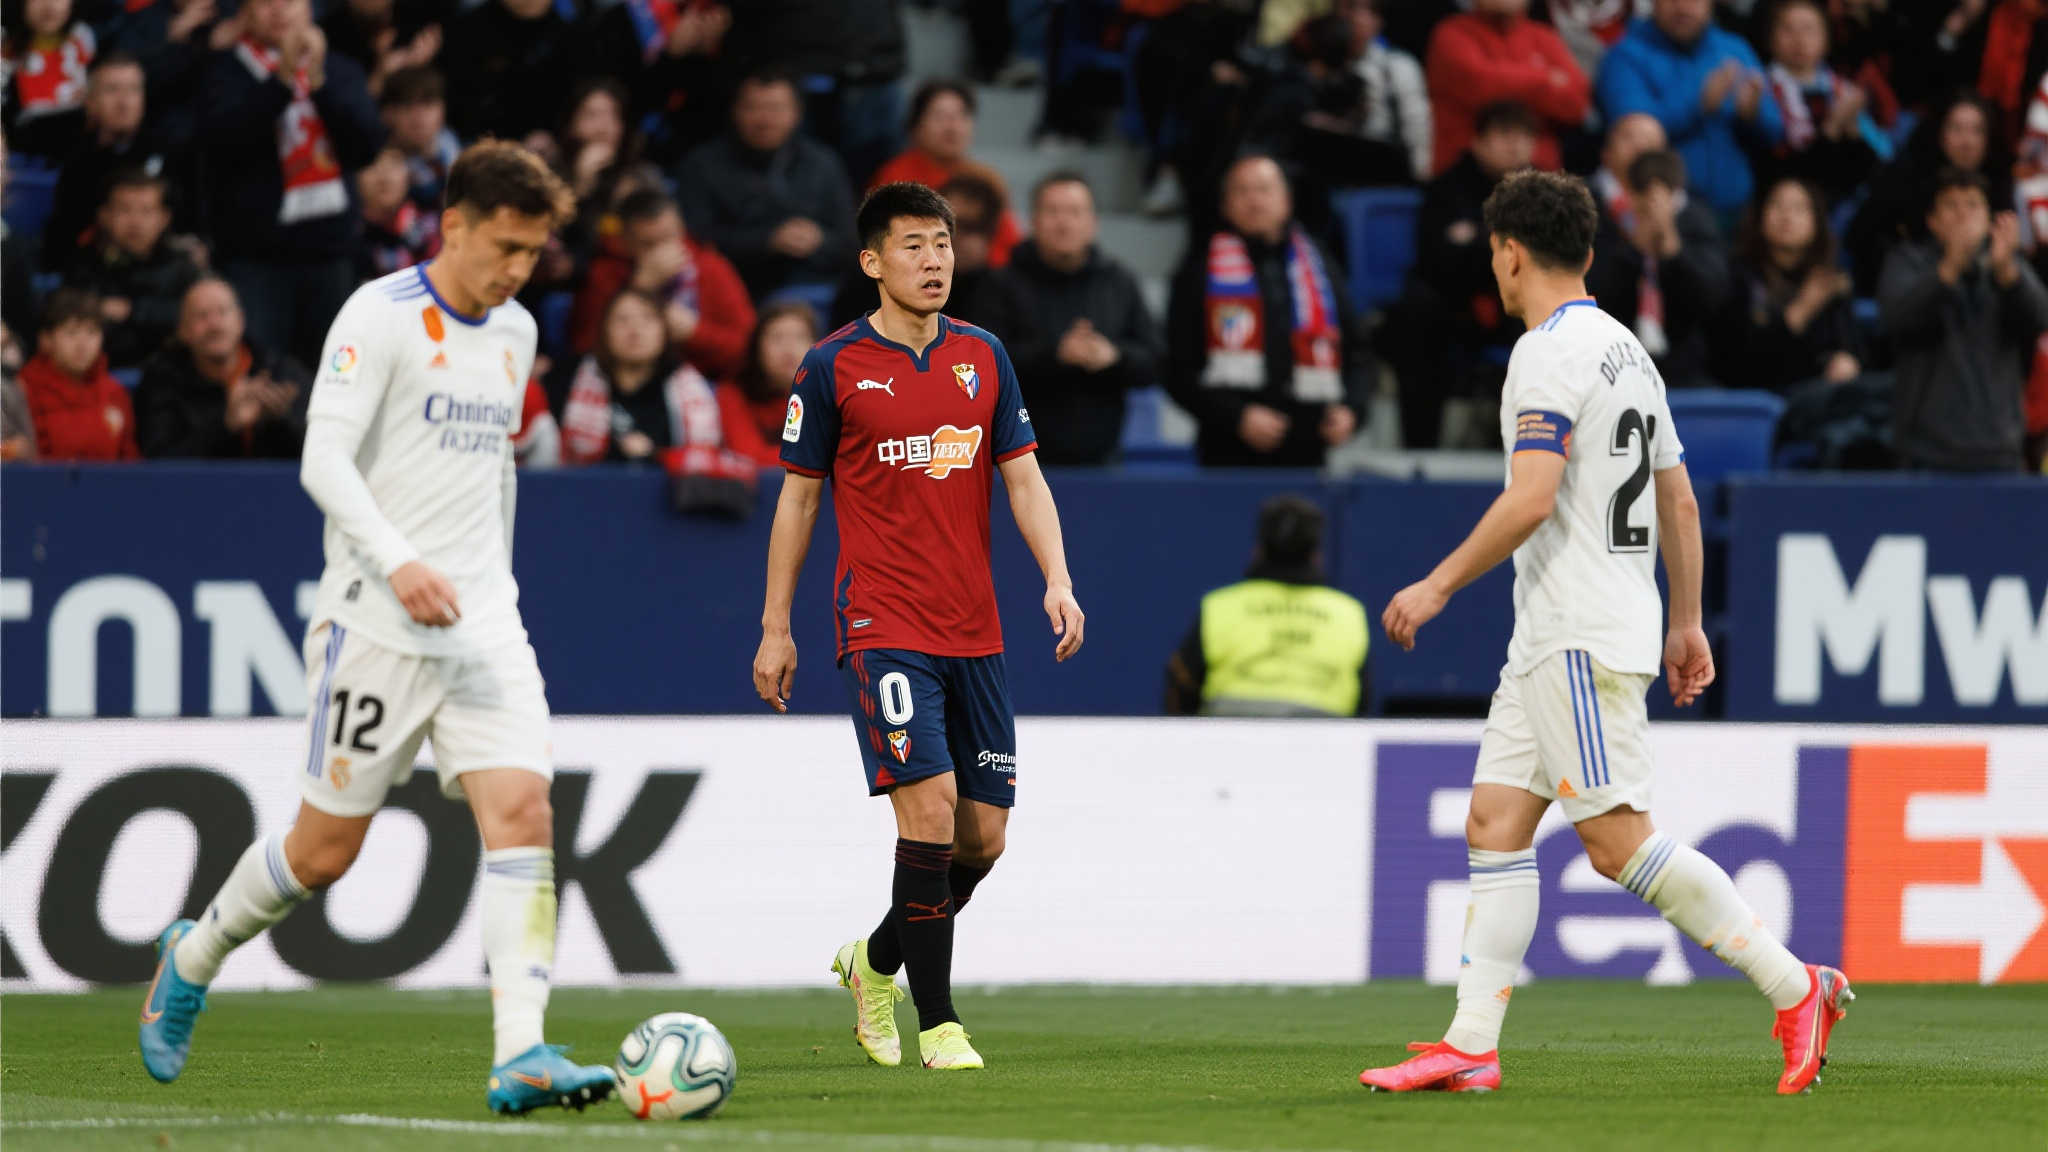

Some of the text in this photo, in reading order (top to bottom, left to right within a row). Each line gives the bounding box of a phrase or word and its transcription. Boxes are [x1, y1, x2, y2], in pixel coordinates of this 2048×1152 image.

[333, 690, 384, 753] 12
[879, 671, 914, 726] 0
[0, 766, 703, 984] OOK
